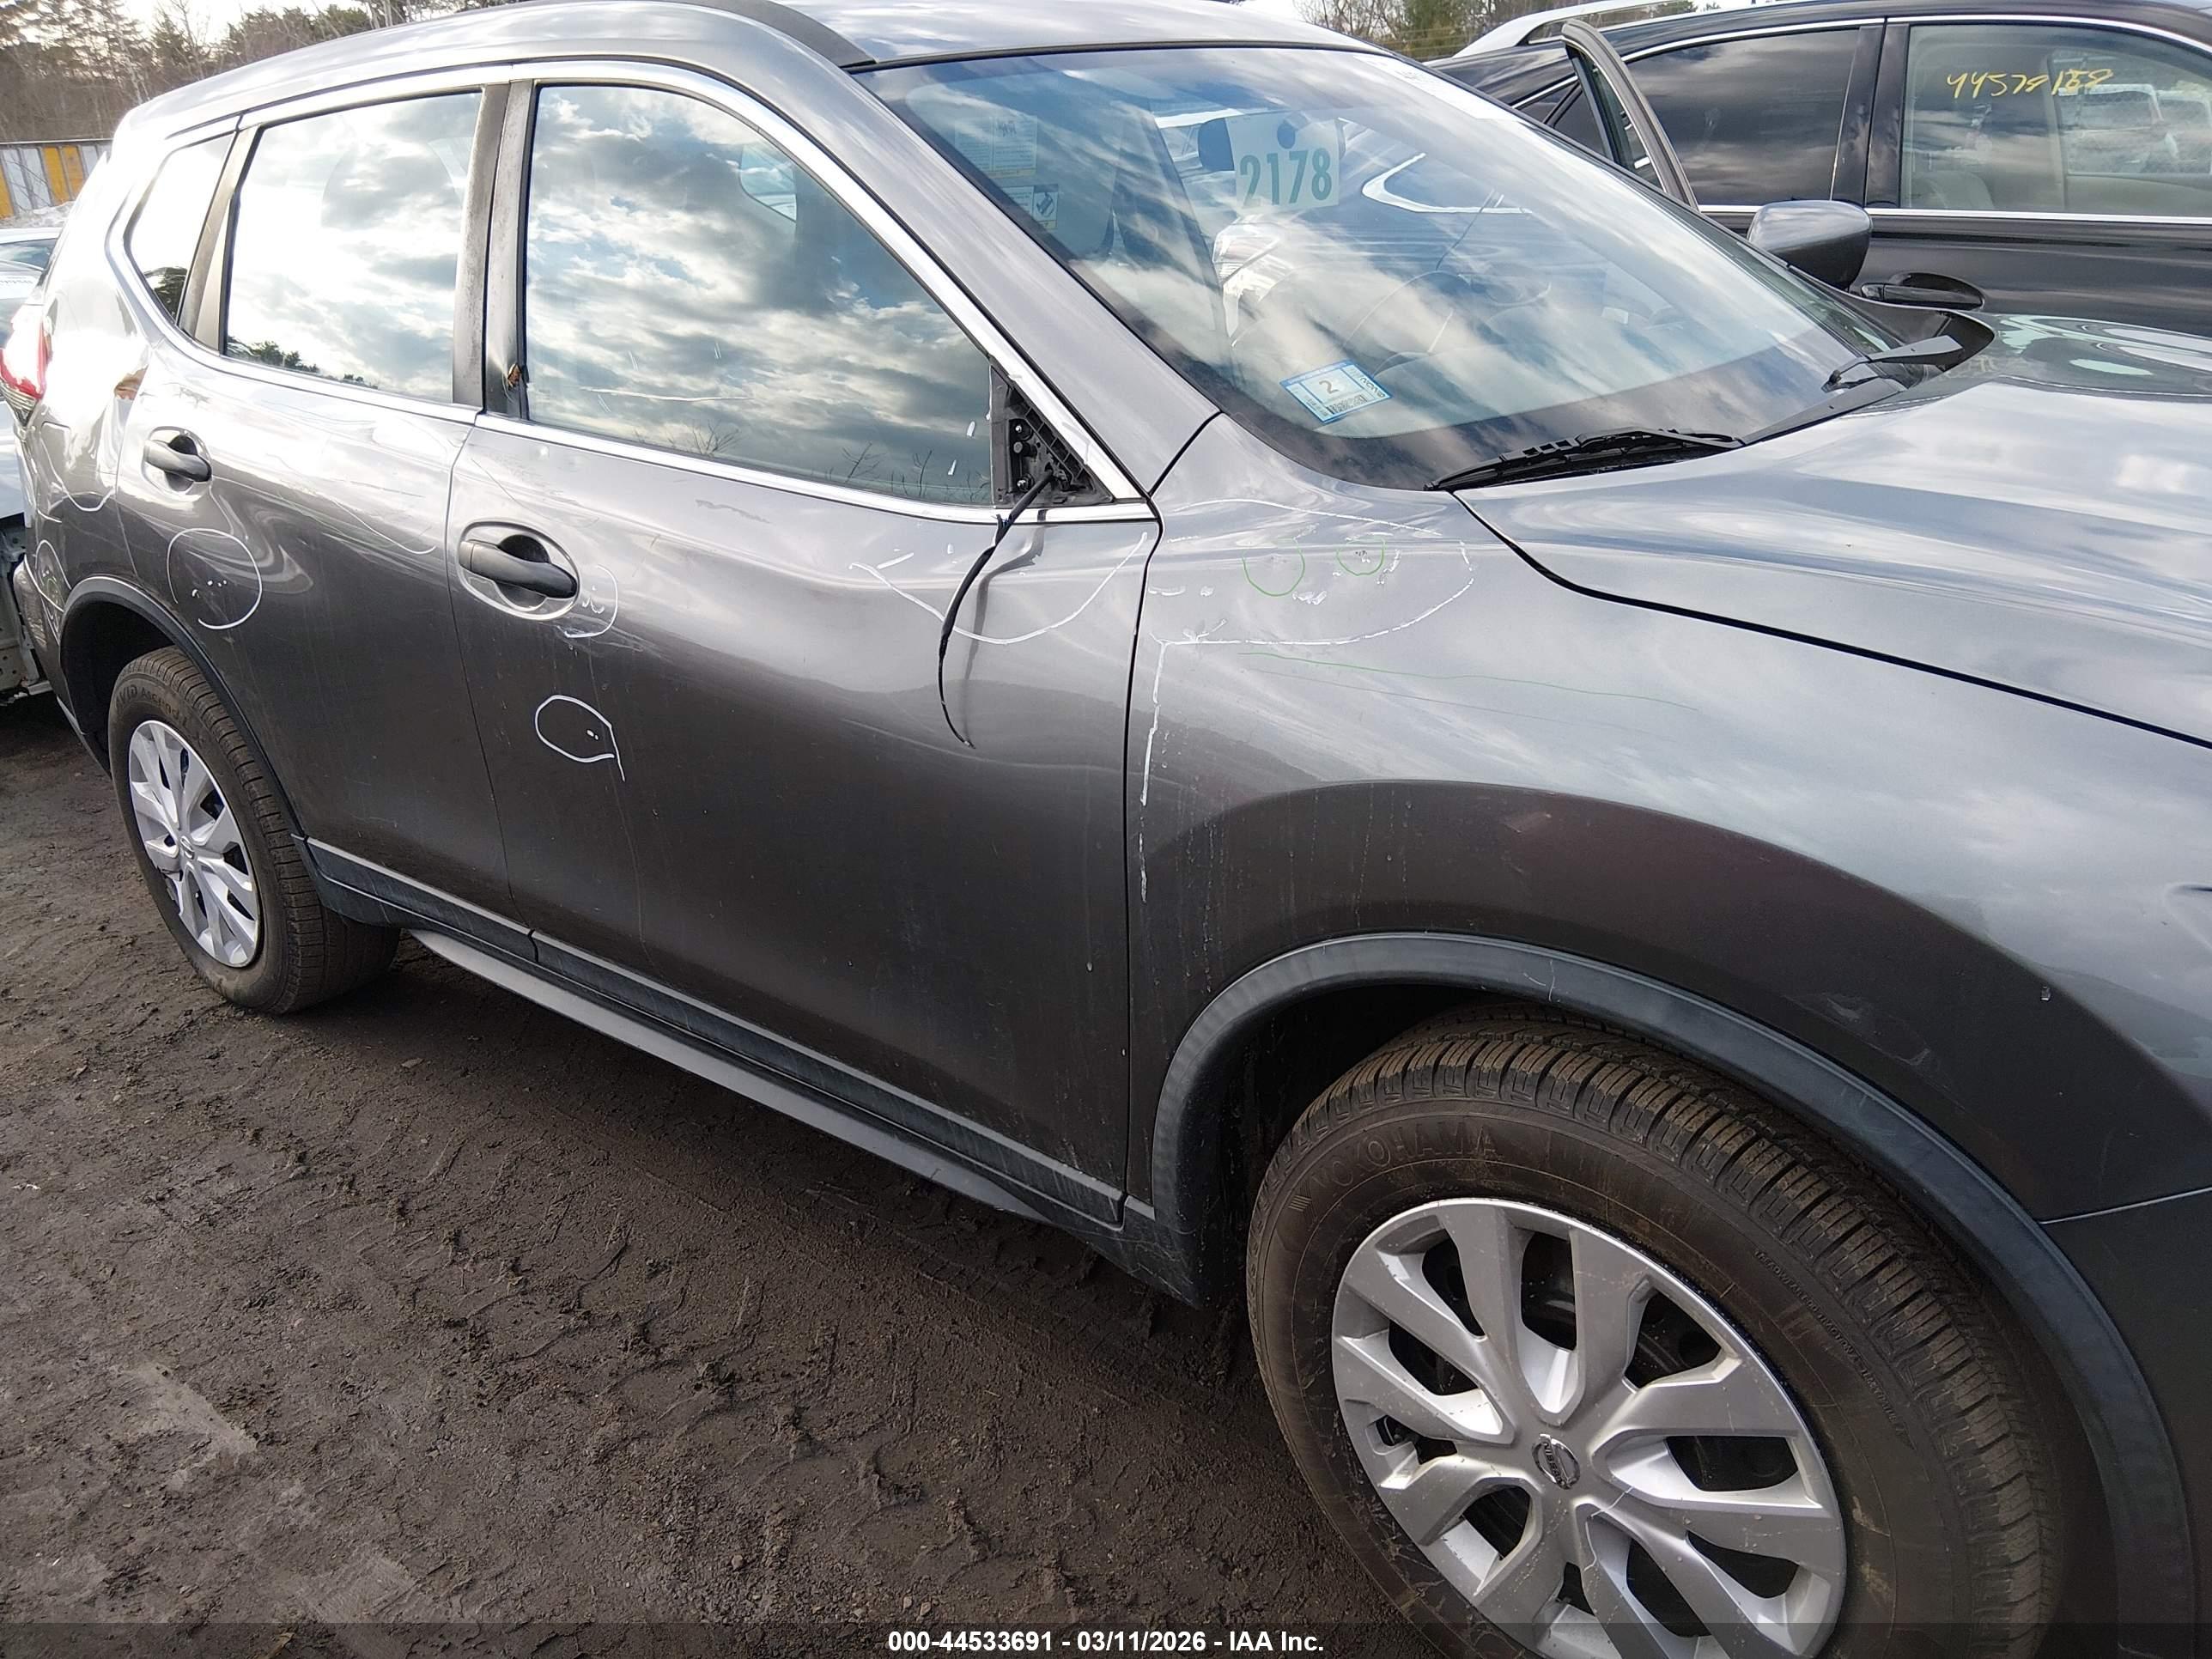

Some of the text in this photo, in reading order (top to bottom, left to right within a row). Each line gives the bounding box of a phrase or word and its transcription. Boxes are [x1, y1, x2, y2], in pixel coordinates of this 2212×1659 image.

[1240, 147, 1333, 209] 2178
[1318, 380, 1340, 394] 2
[1542, 1442, 1563, 1485] NISSAN
